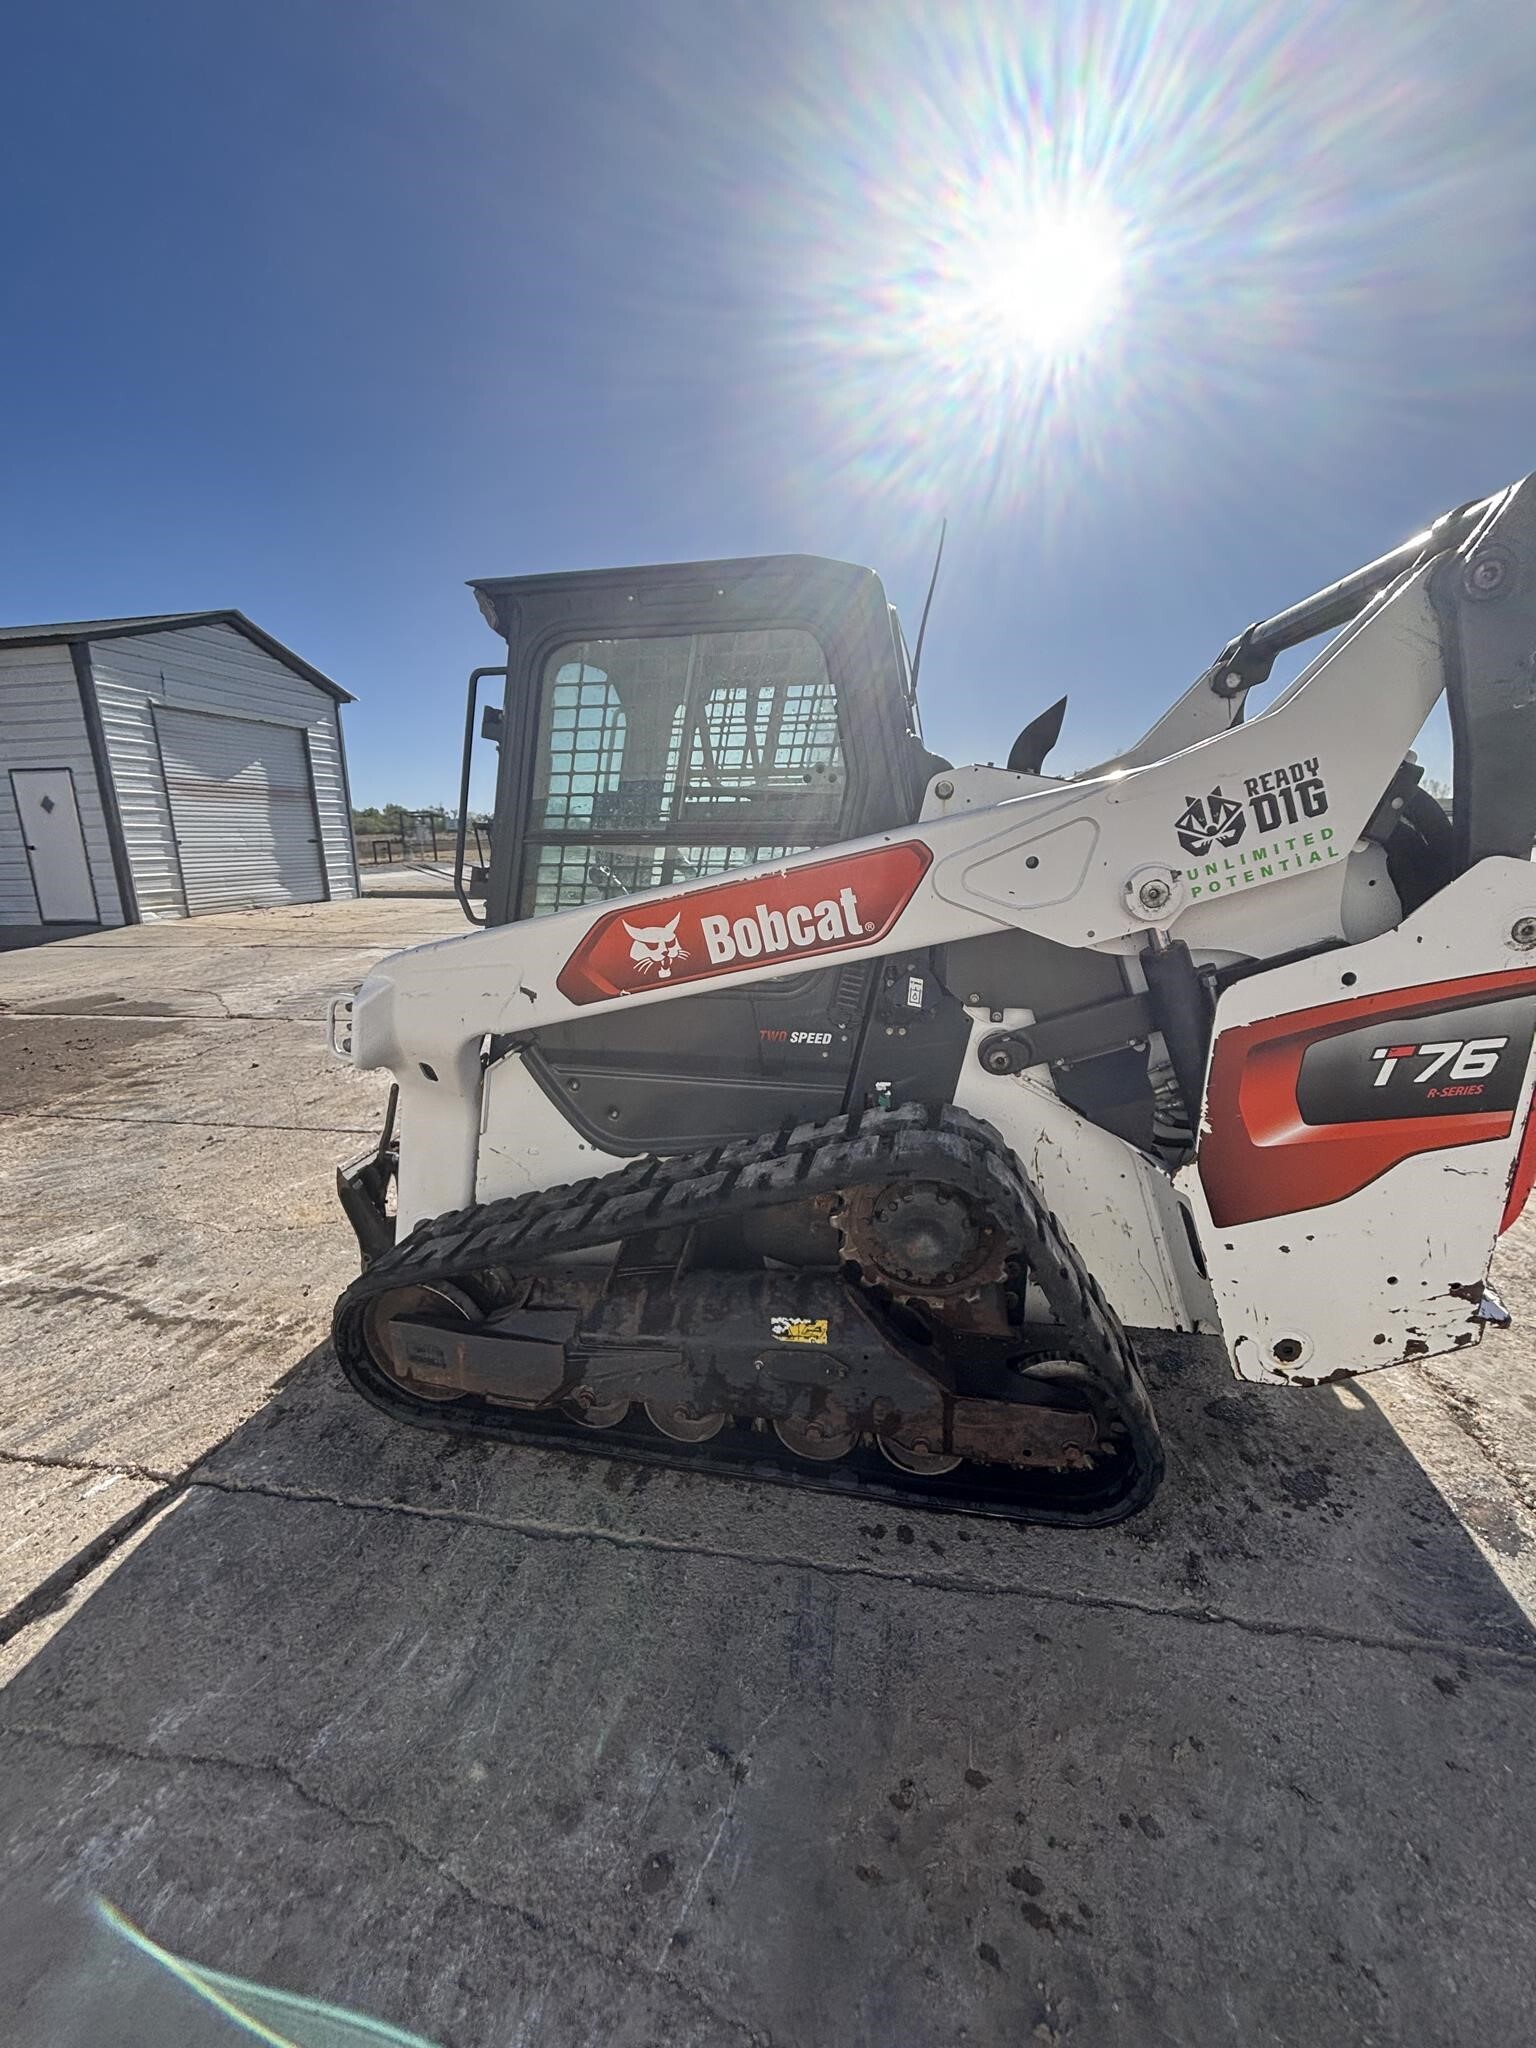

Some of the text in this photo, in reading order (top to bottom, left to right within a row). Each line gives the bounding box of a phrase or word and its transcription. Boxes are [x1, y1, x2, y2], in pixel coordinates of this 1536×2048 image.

[1243, 757, 1320, 798] READY
[1186, 827, 1334, 881] UNLIMITED
[1190, 846, 1339, 898] POTENTIAL
[700, 887, 863, 965] Bobcat
[759, 1029, 833, 1045] TWO SPEED
[1371, 1037, 1509, 1087] T76
[1427, 1085, 1485, 1099] R-SERIES
